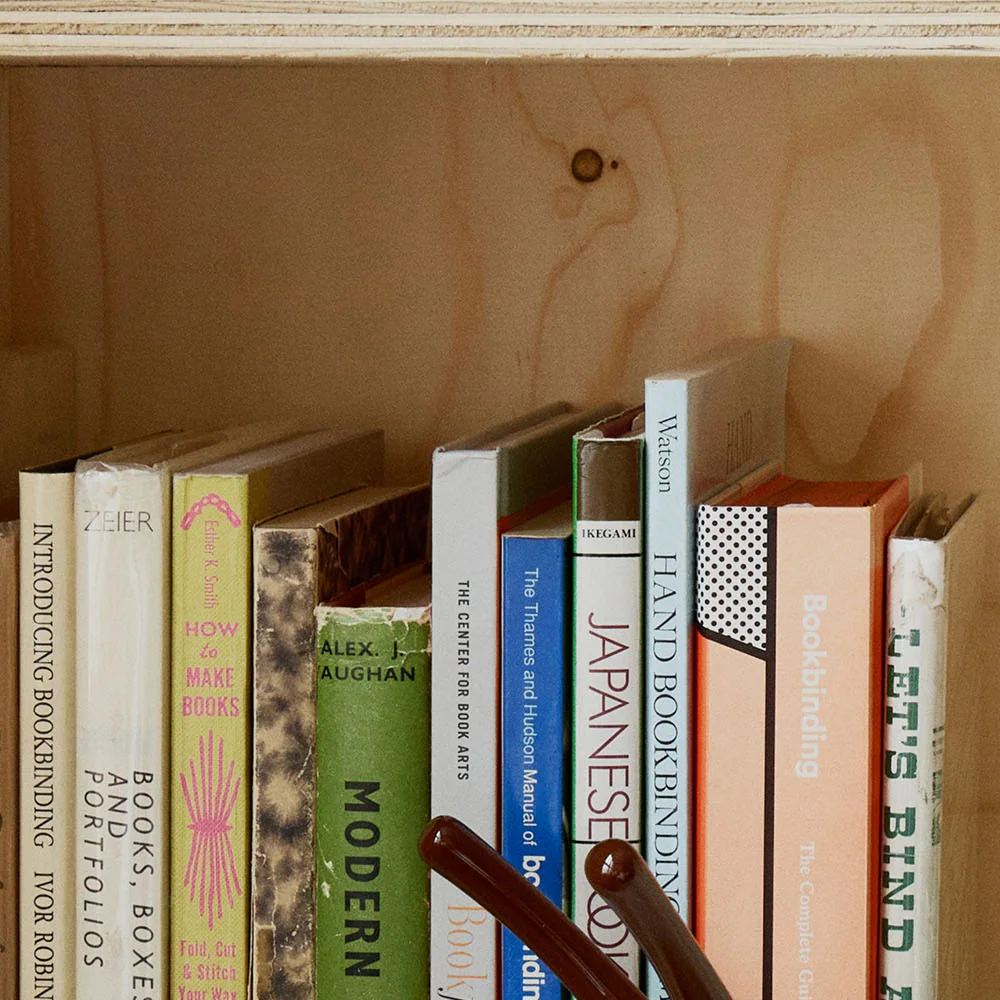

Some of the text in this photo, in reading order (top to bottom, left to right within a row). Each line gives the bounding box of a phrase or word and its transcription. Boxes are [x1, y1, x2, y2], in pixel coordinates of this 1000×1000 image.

[658, 416, 677, 492] Watson
[83, 510, 154, 533] ZEIER
[204, 520, 219, 555] Esther
[582, 528, 636, 539] IKEGAMI
[33, 524, 53, 681] INTRODUCING
[204, 575, 220, 609] Smith
[524, 568, 539, 598] The
[654, 555, 676, 661] HAND
[185, 621, 239, 636] HOW
[200, 643, 218, 659] to
[320, 640, 404, 660] ALEX. J.
[524, 602, 539, 666] Thames
[186, 667, 234, 688] MAKE
[319, 665, 415, 682] AUGHAN
[457, 581, 469, 780] THE CENTER FOR BOOK ARTS
[523, 670, 538, 699] and
[795, 595, 827, 777] Bookbinding
[182, 696, 240, 717] BOOKS
[588, 613, 629, 840] JAPANESE
[523, 704, 538, 764] Hudson
[34, 688, 54, 848] BOOKBINDING
[107, 772, 128, 838] AND
[523, 769, 538, 826] Manual
[130, 771, 153, 886] BOOKS,
[523, 831, 538, 846] of
[83, 770, 104, 967] PORTFOLIOS
[345, 782, 380, 976] MODERN
[800, 842, 815, 874] The
[882, 806, 916, 952] BIND
[34, 872, 54, 925] IVOR
[797, 881, 816, 963] Complete
[180, 940, 237, 959] Fold, Cut
[183, 963, 236, 980] & Stitch
